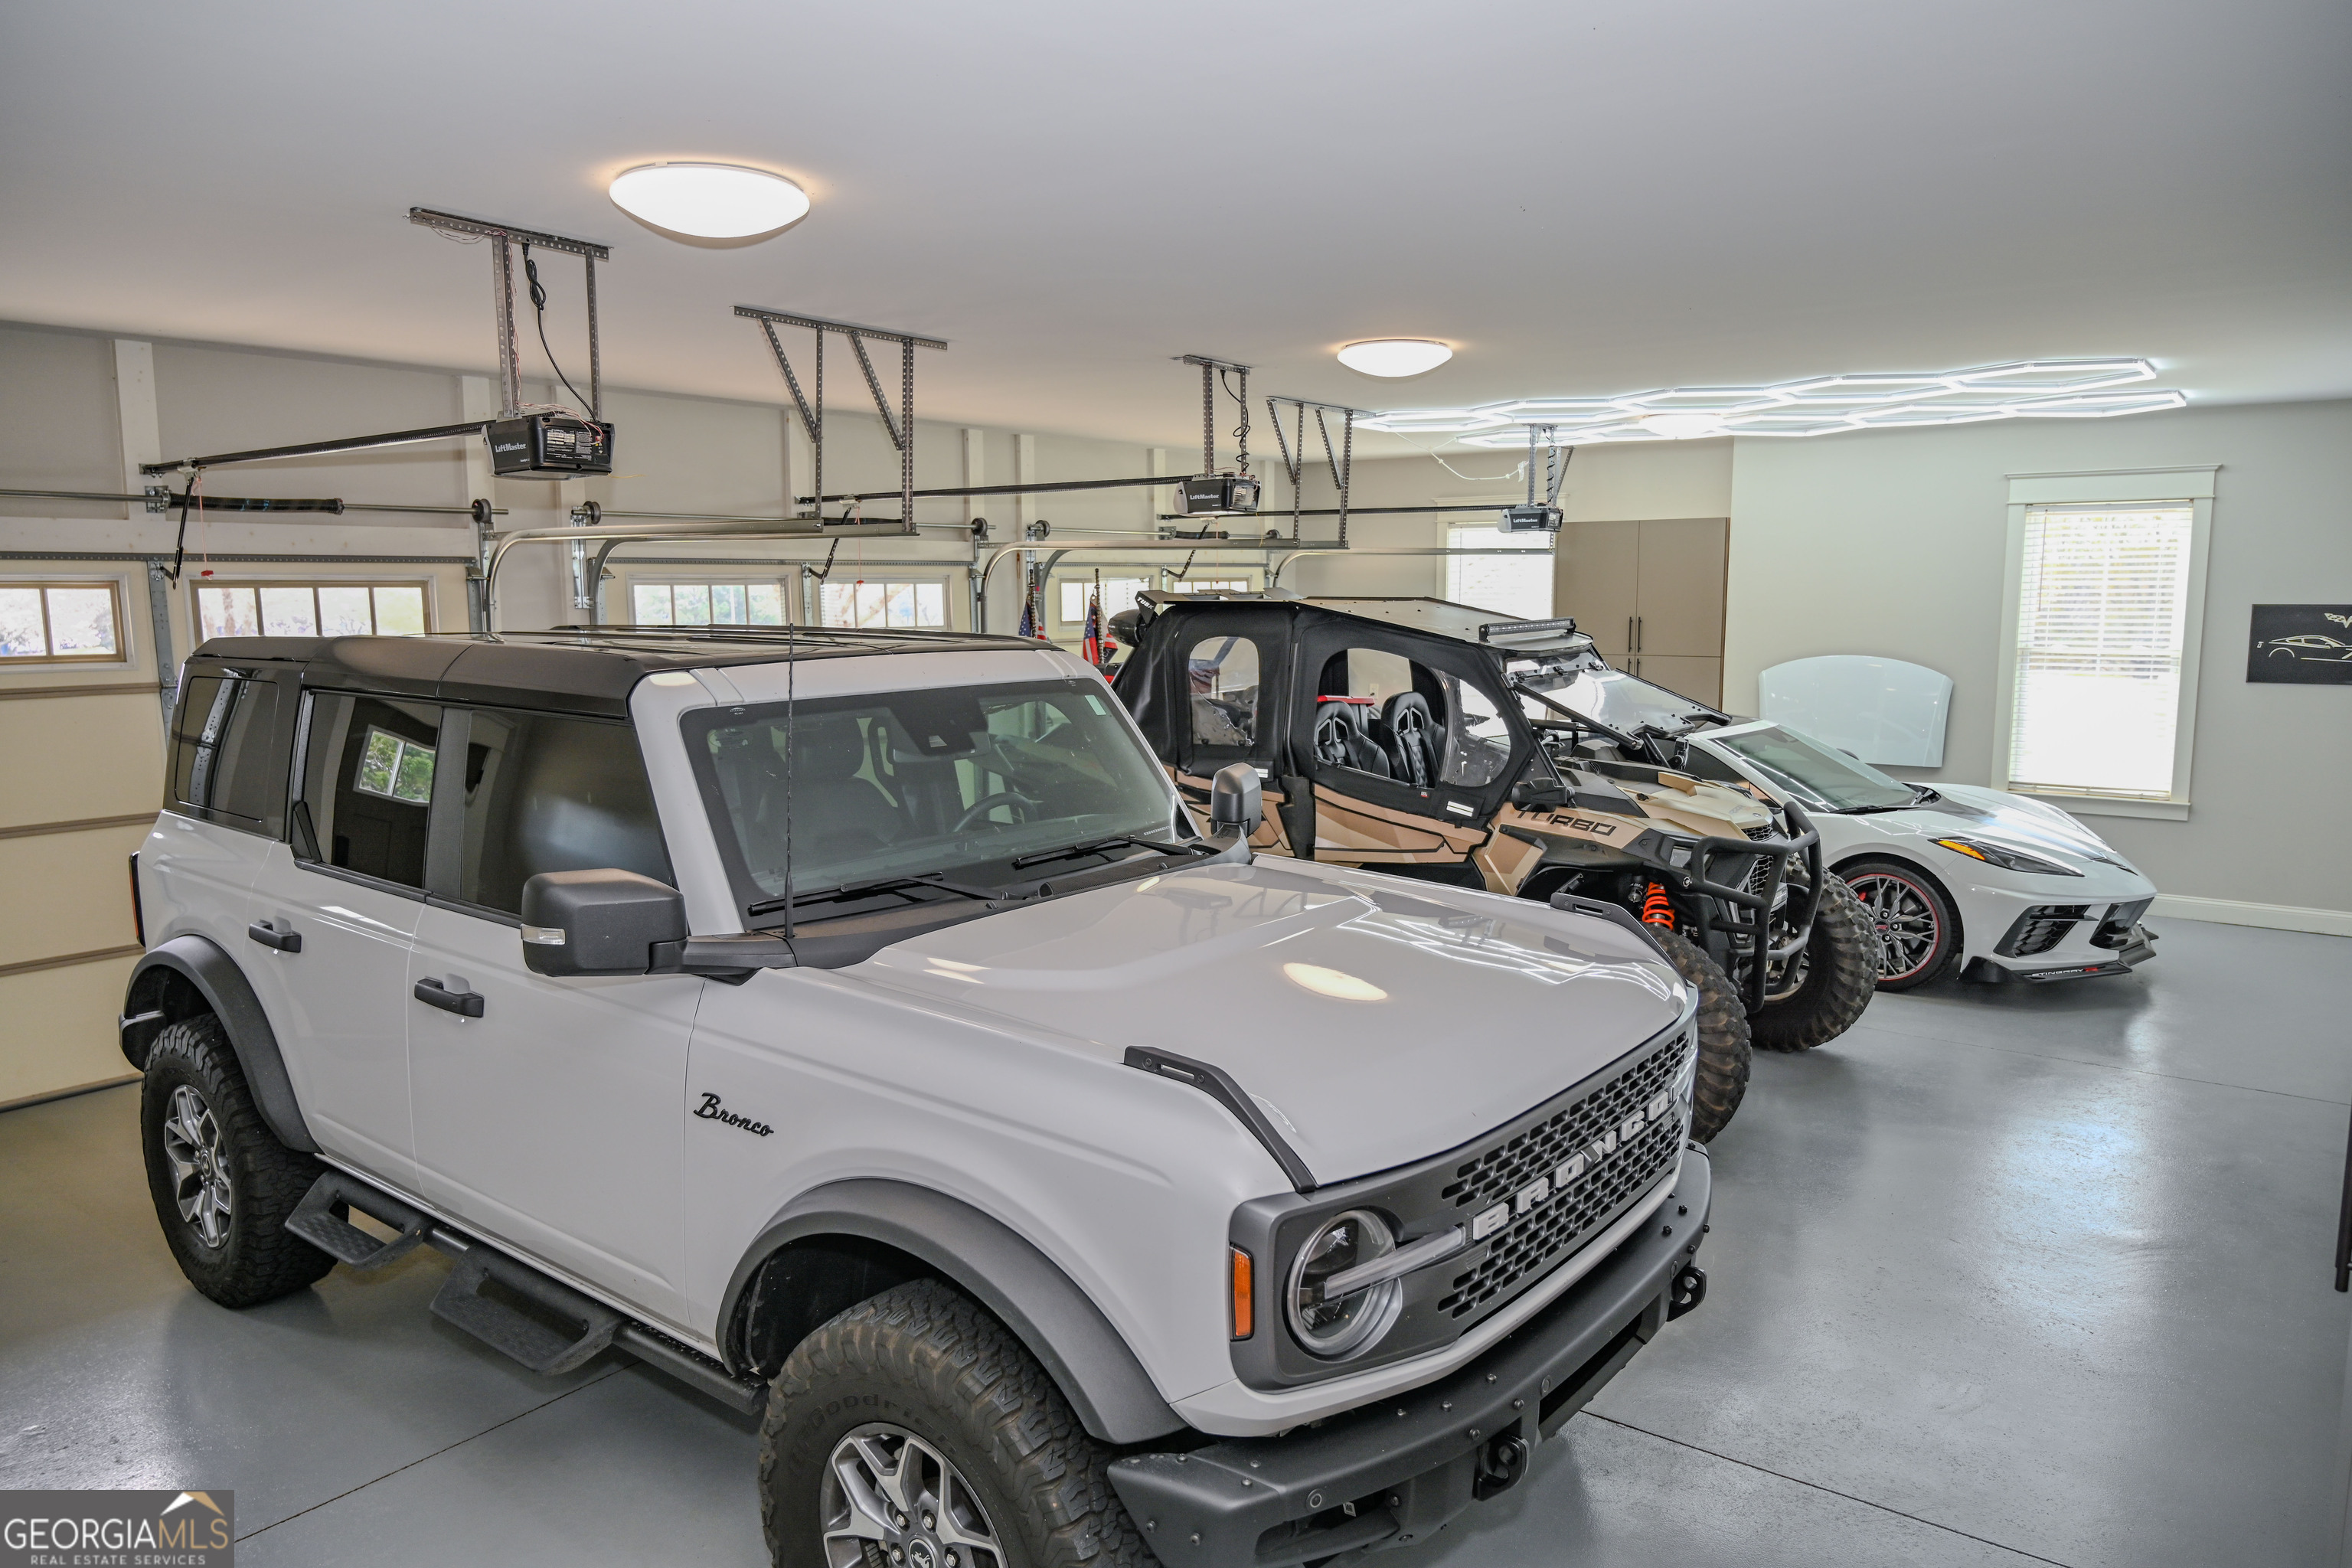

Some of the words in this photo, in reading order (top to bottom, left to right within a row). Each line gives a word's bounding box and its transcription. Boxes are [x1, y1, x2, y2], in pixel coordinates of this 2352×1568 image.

[495, 443, 527, 452] LiftMaster
[693, 1092, 774, 1137] Bronco
[1473, 1091, 1668, 1240] BRONCO
